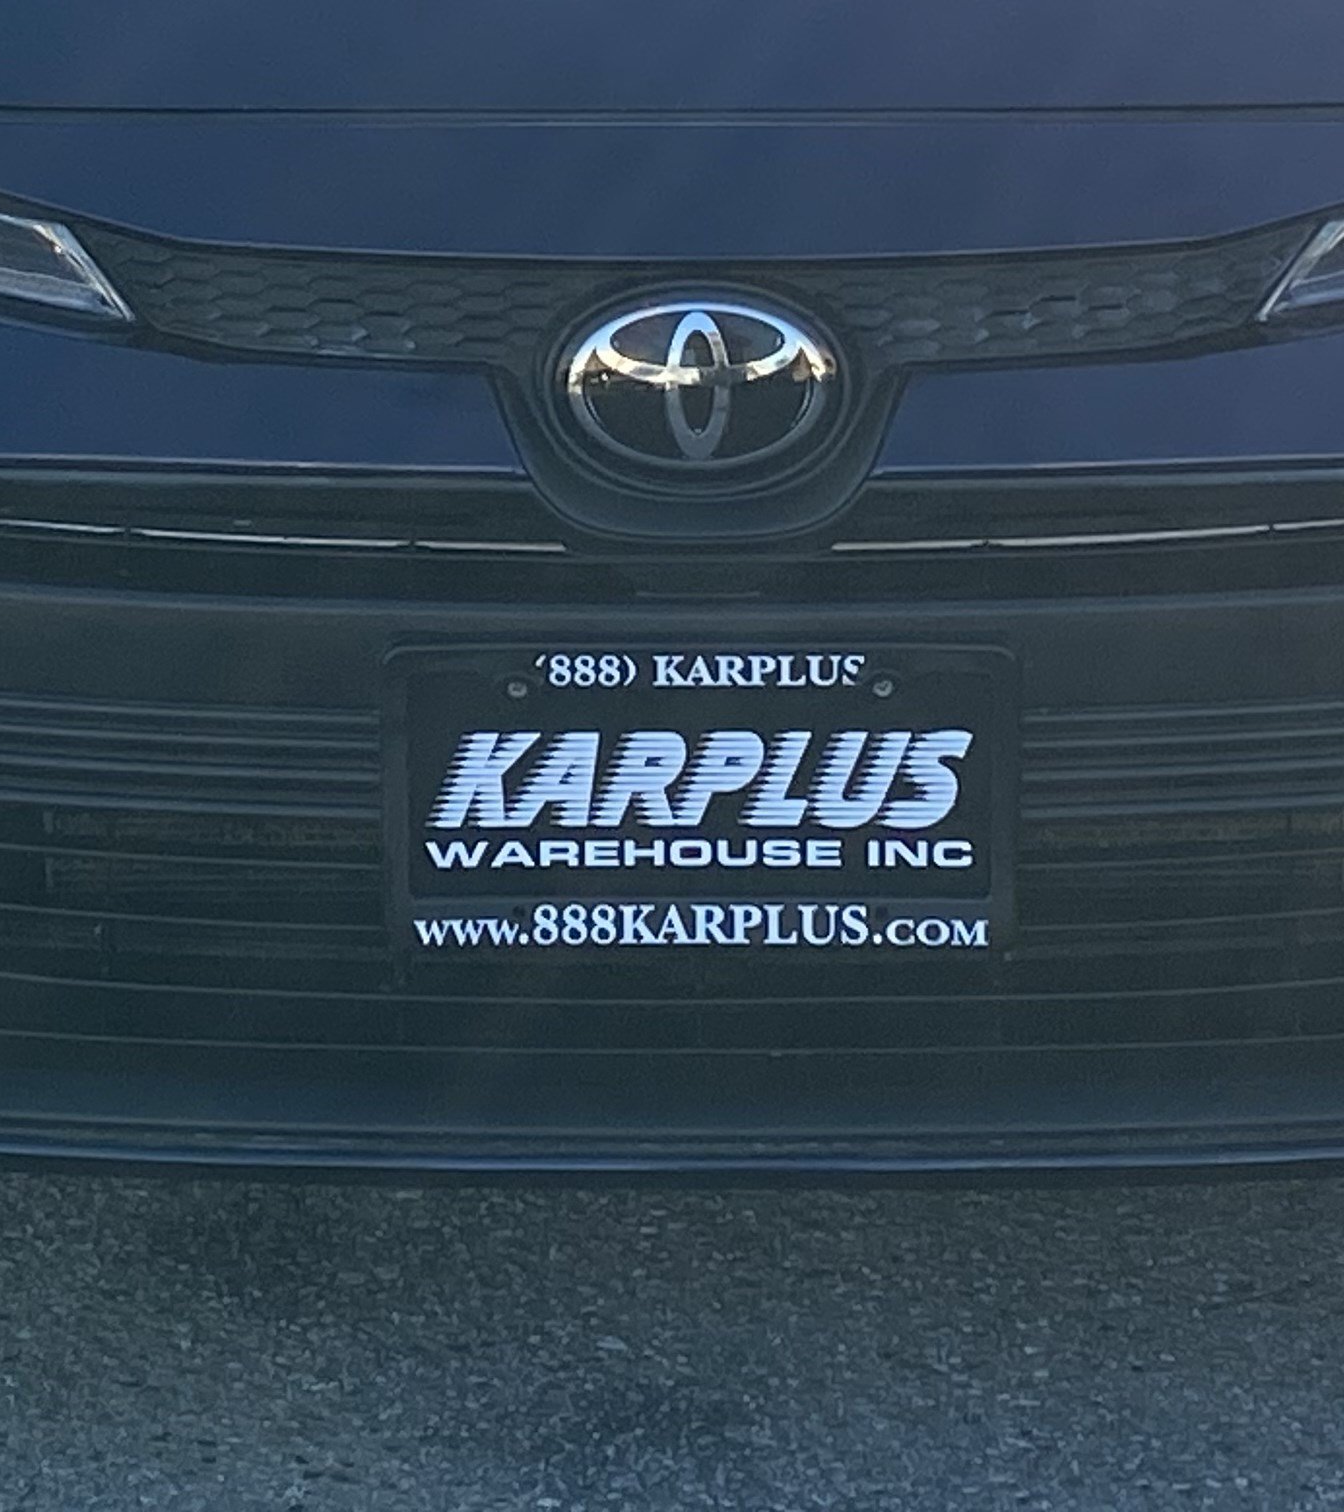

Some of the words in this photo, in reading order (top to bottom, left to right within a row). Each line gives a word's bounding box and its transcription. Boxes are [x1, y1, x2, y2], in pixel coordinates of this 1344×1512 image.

[652, 654, 866, 688] KARPLUS
[426, 729, 974, 830] KARPLUS
[425, 838, 842, 869] WAREHOUSE
[867, 839, 974, 868] INC
